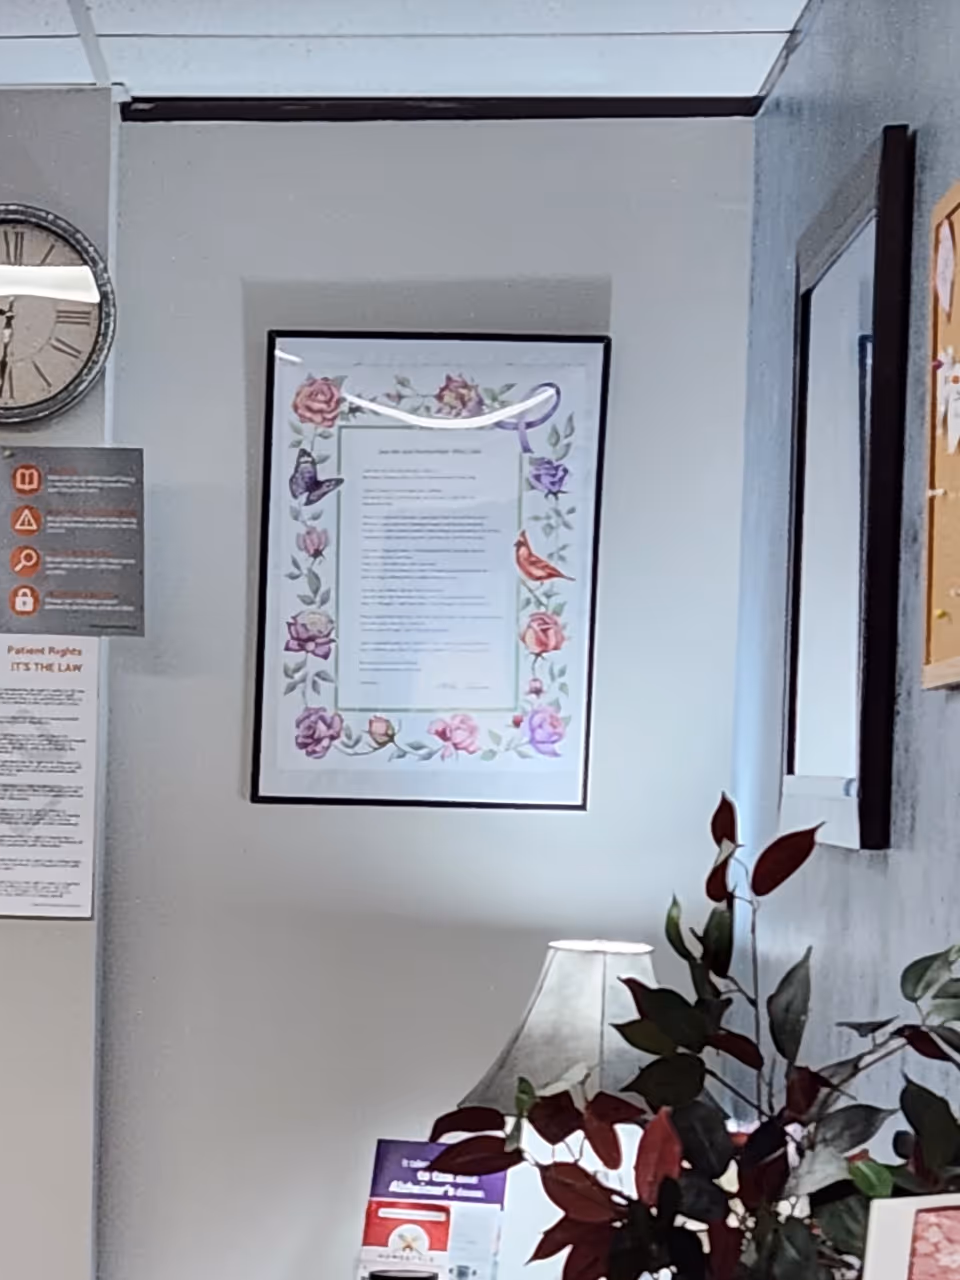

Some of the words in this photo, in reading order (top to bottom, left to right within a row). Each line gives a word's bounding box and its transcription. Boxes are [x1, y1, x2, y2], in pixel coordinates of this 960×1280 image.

[7, 645, 45, 656] Patient
[48, 646, 83, 658] Rights
[10, 662, 31, 672] IT'S
[34, 662, 55, 673] THE
[58, 663, 83, 673] LAW
